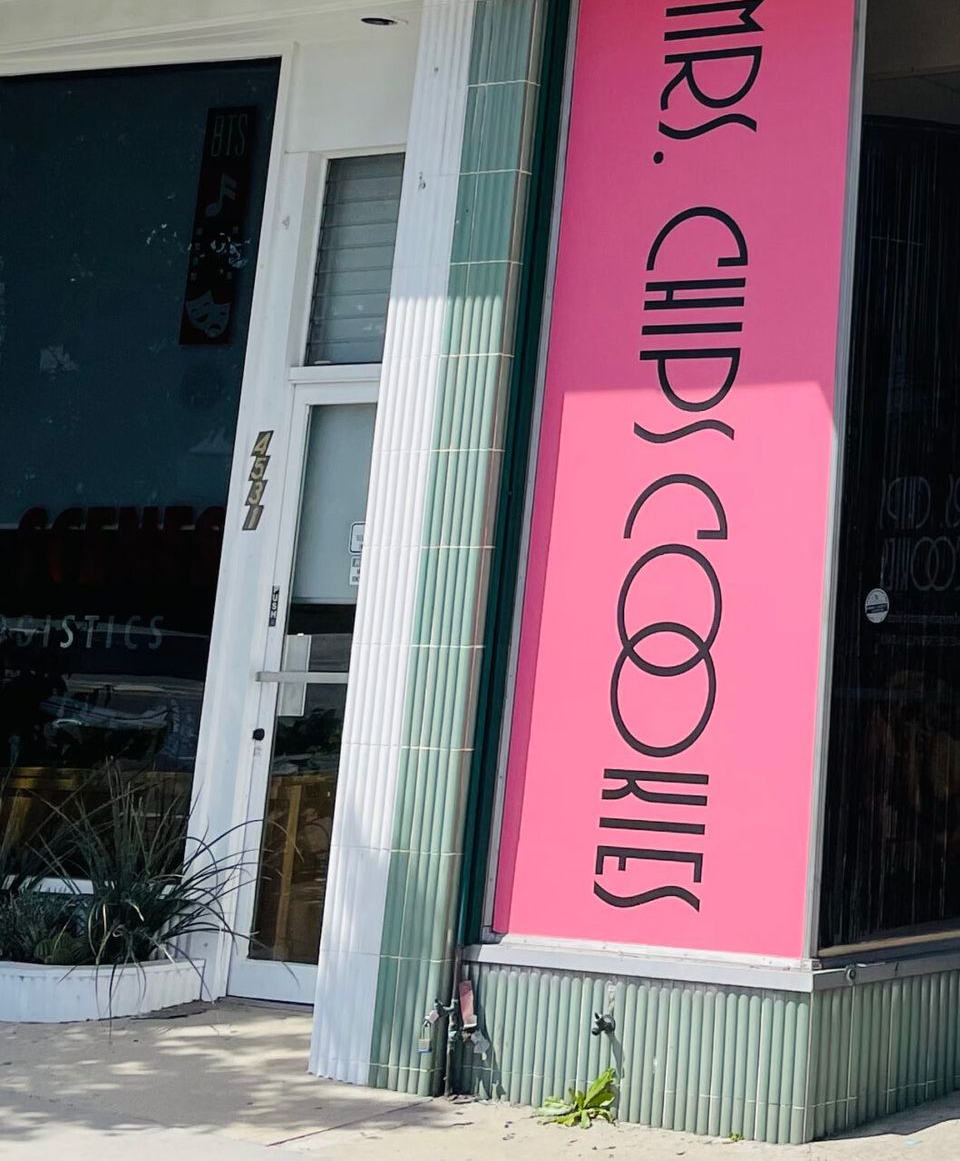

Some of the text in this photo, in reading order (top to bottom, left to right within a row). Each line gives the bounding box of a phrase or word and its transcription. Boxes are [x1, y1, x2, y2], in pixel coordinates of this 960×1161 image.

[633, 206, 749, 445] CHIPS
[245, 431, 273, 529] 4531
[593, 473, 729, 913] COOKIES
